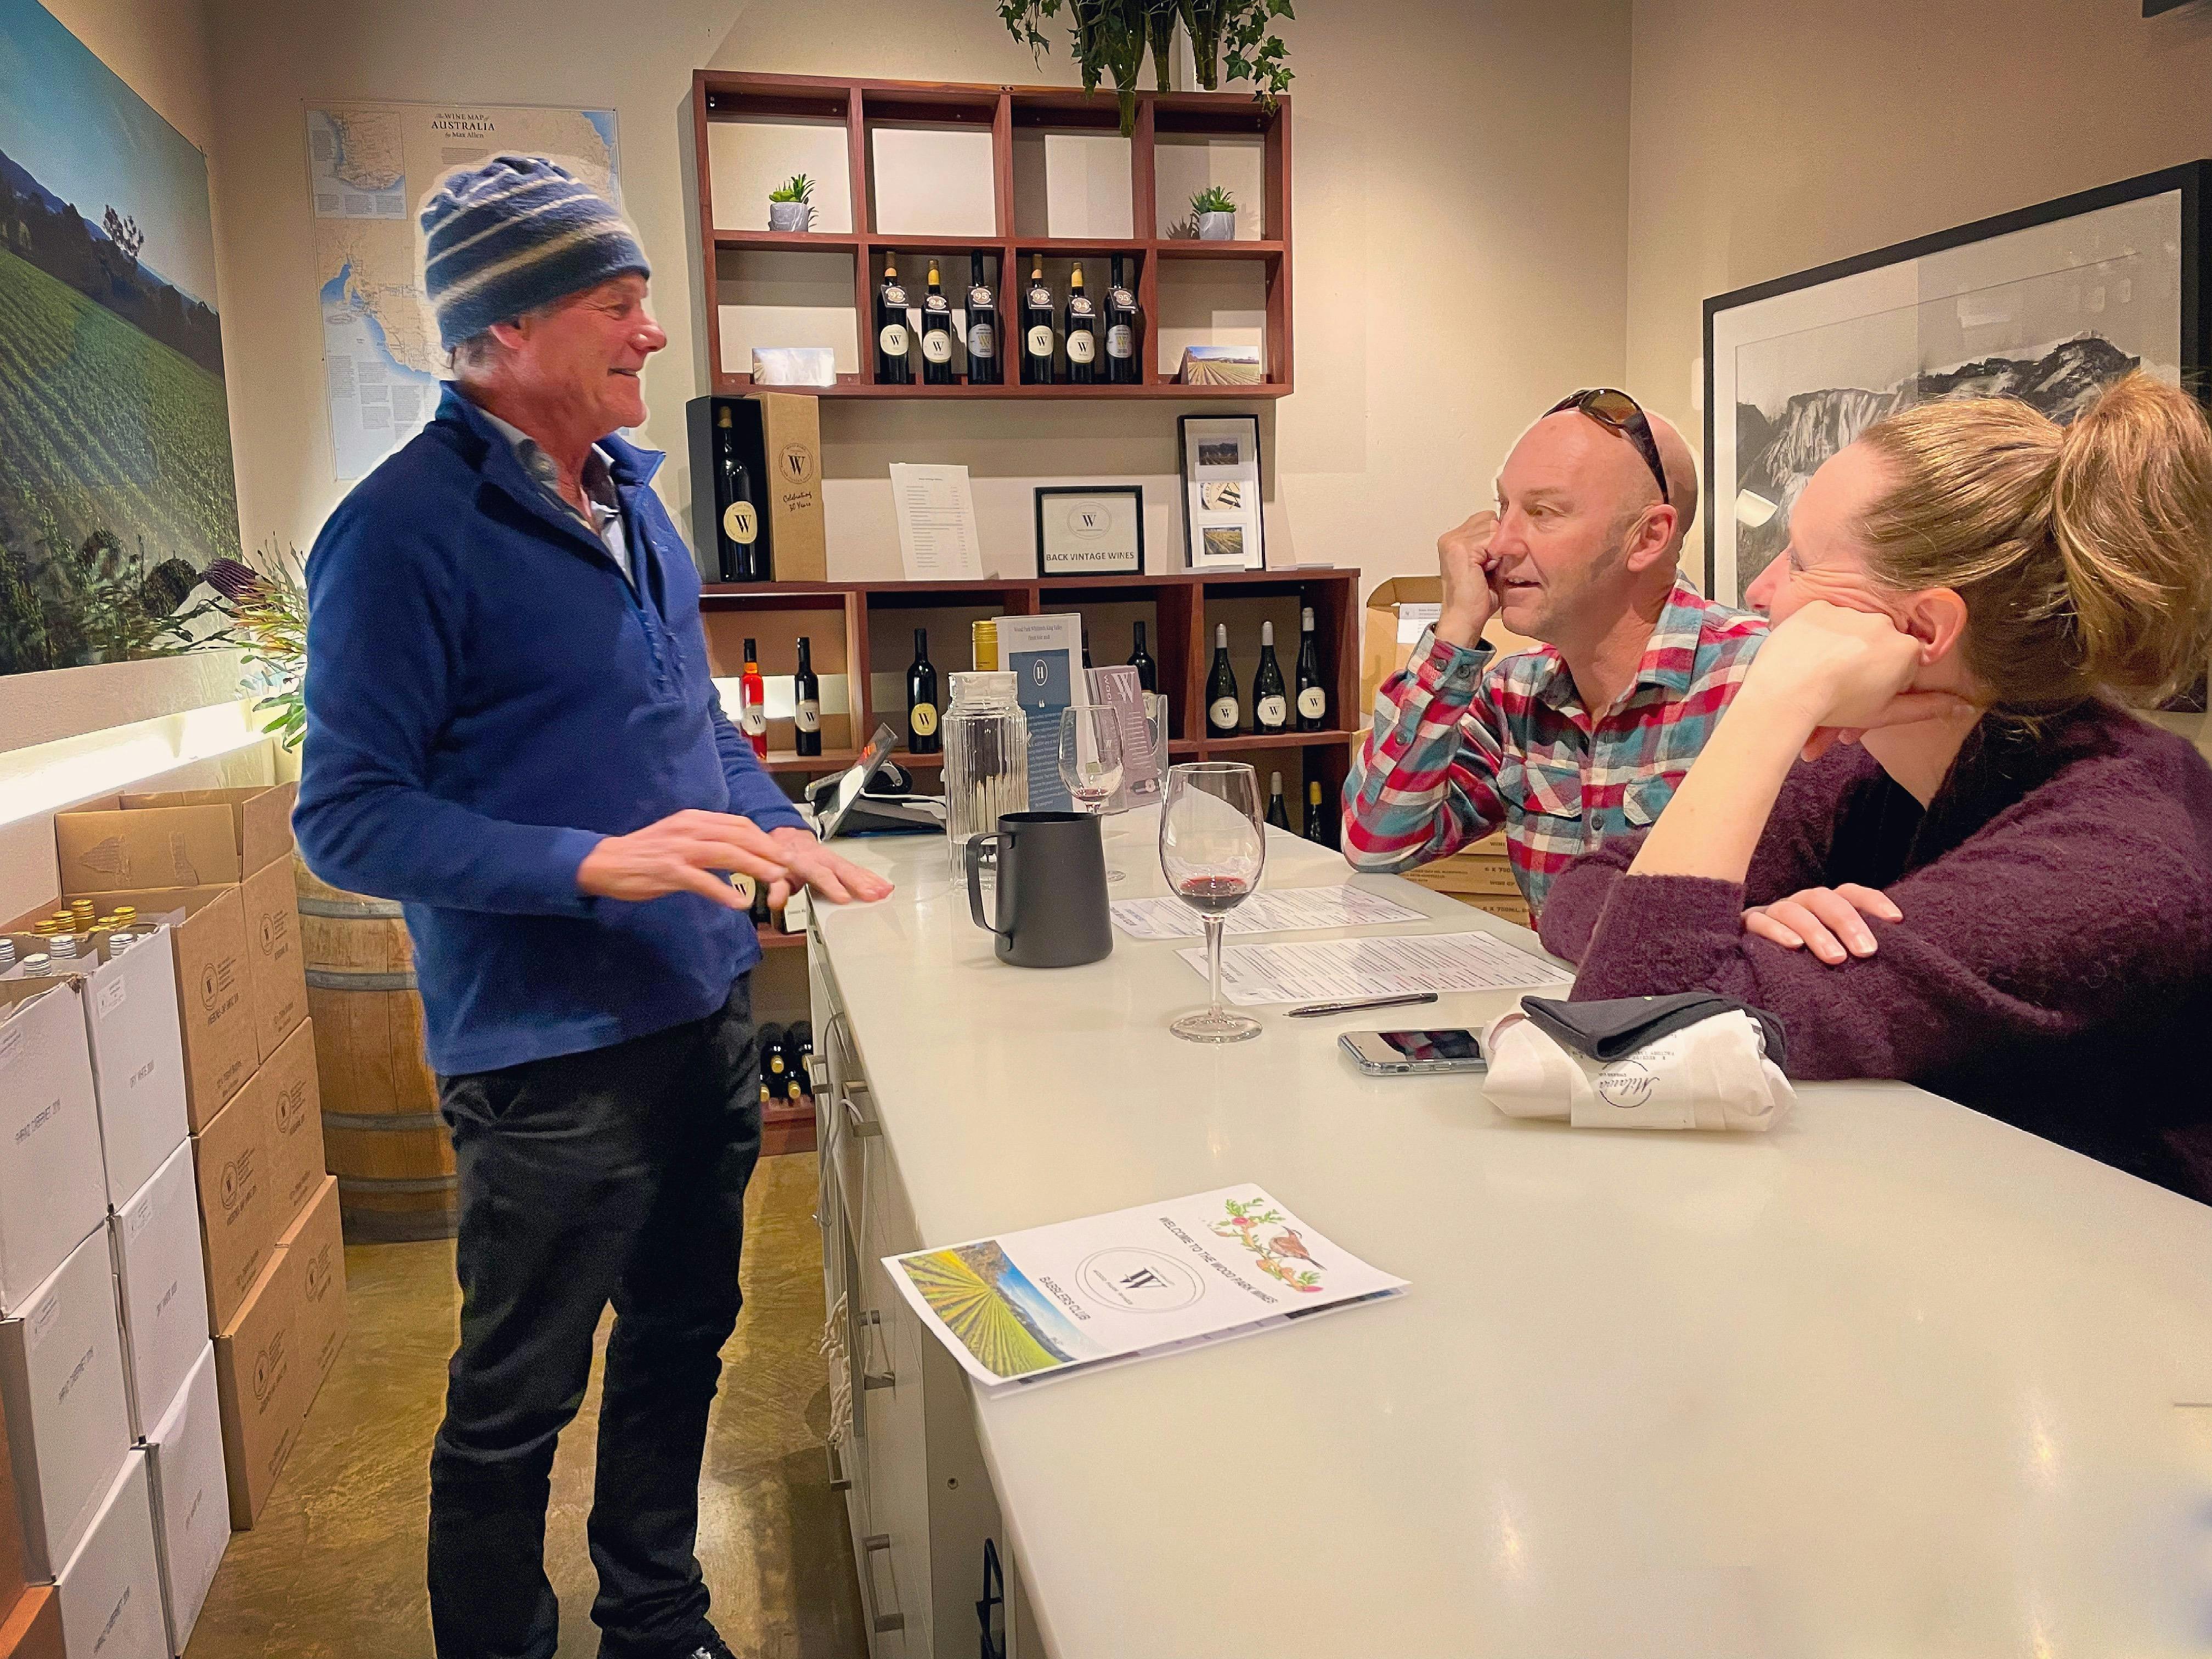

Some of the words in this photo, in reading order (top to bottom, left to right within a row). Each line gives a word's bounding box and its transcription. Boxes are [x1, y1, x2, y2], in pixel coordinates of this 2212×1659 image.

[431, 120, 495, 131] AUSTRALIA
[890, 292, 904, 300] 92
[976, 292, 988, 300] 95
[889, 335, 901, 346] W
[1036, 336, 1048, 346] W
[932, 341, 944, 352] W
[1077, 342, 1089, 352] W
[788, 455, 805, 476] W
[734, 515, 752, 533] W
[1082, 515, 1097, 527] W
[1070, 552, 1106, 560] VINTAGE
[1107, 551, 1134, 560] WINES
[1111, 671, 1135, 703] W
[1309, 698, 1320, 707] W
[1221, 708, 1231, 718] W
[1269, 706, 1280, 716] W
[918, 713, 933, 726] W
[1159, 1216, 1194, 1244] WELCOME
[1189, 1243, 1203, 1252] TO
[1198, 1251, 1217, 1263] THE
[1211, 1262, 1237, 1278] WOOD
[1231, 1277, 1256, 1291] PARK
[1250, 1290, 1279, 1304] WINES
[1119, 1267, 1169, 1289] W
[1039, 1276, 1075, 1305] BABBLERS
[1069, 1305, 1092, 1320] CLUB
